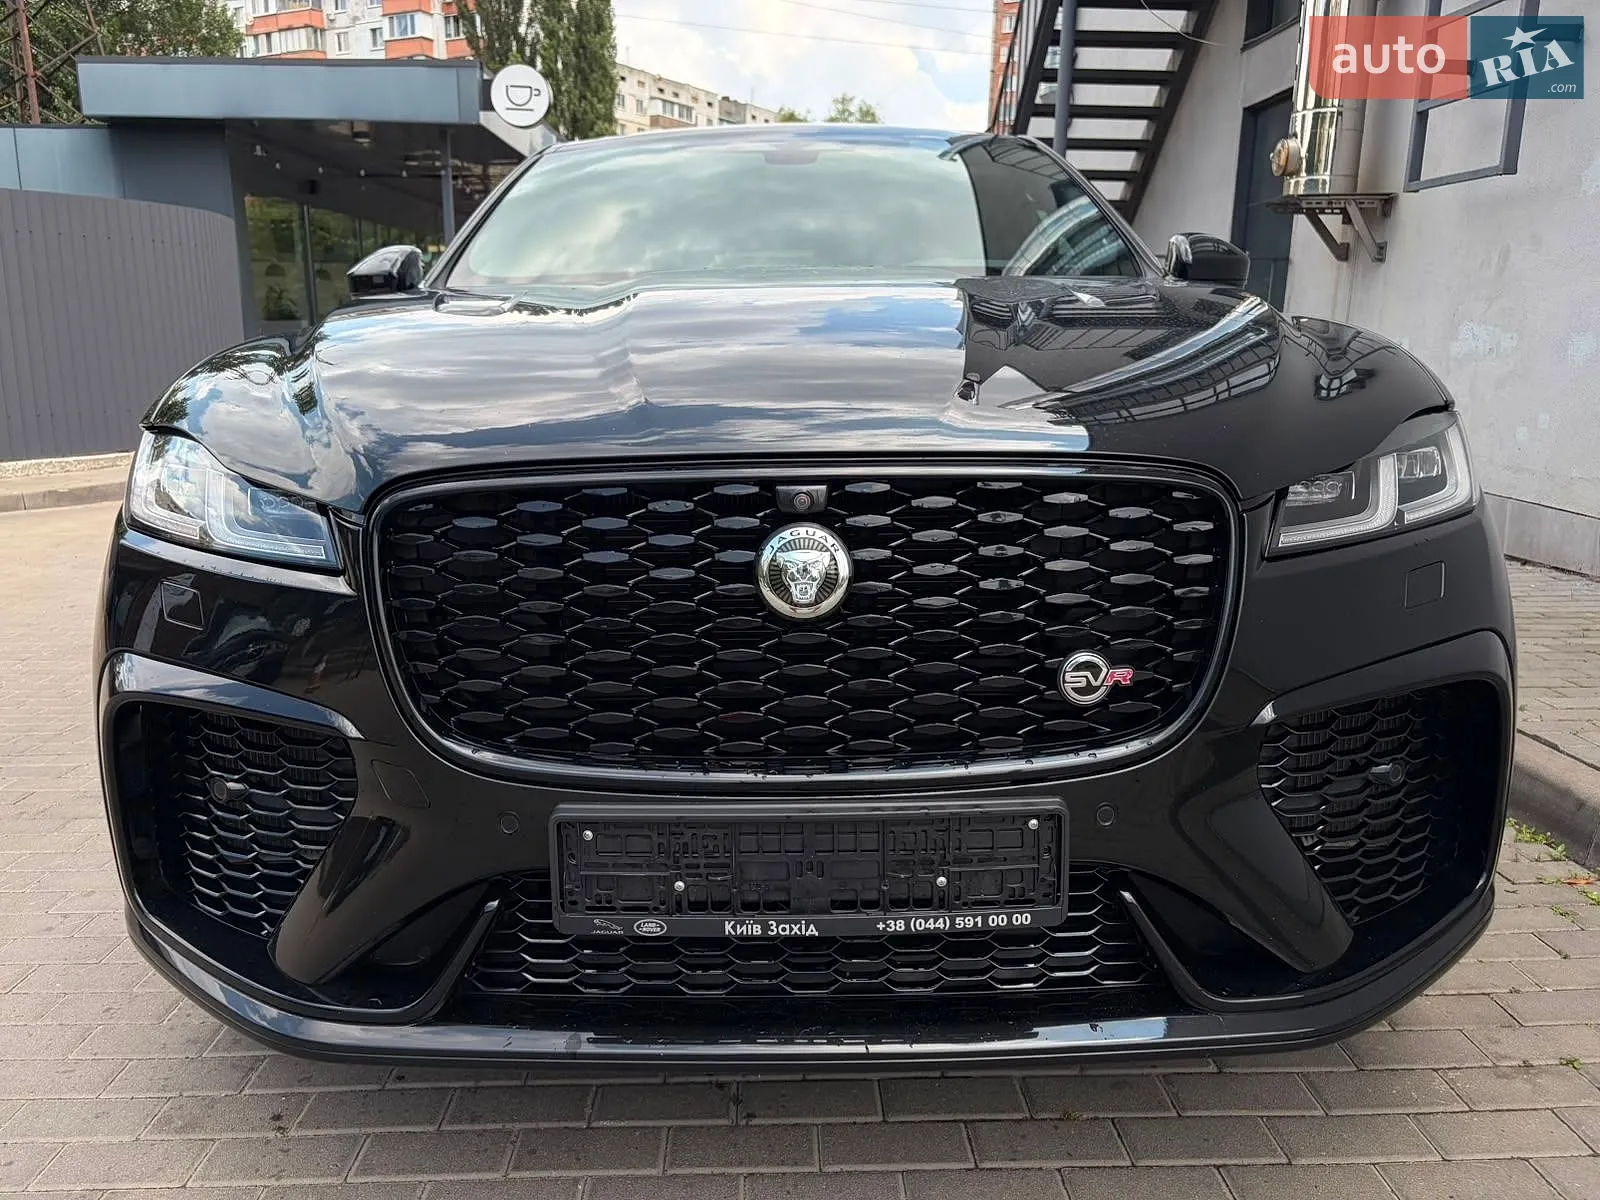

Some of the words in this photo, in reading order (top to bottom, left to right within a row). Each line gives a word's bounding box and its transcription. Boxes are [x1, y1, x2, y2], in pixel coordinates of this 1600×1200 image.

[769, 529, 840, 555] JAGUAR
[1064, 668, 1134, 687] SVR
[724, 920, 762, 936] Київ
[767, 920, 819, 937] Захід
[876, 919, 905, 931] +38
[910, 916, 950, 932] (044)
[954, 915, 983, 929] 591
[988, 914, 1008, 927] 00
[1012, 913, 1031, 925] 00
